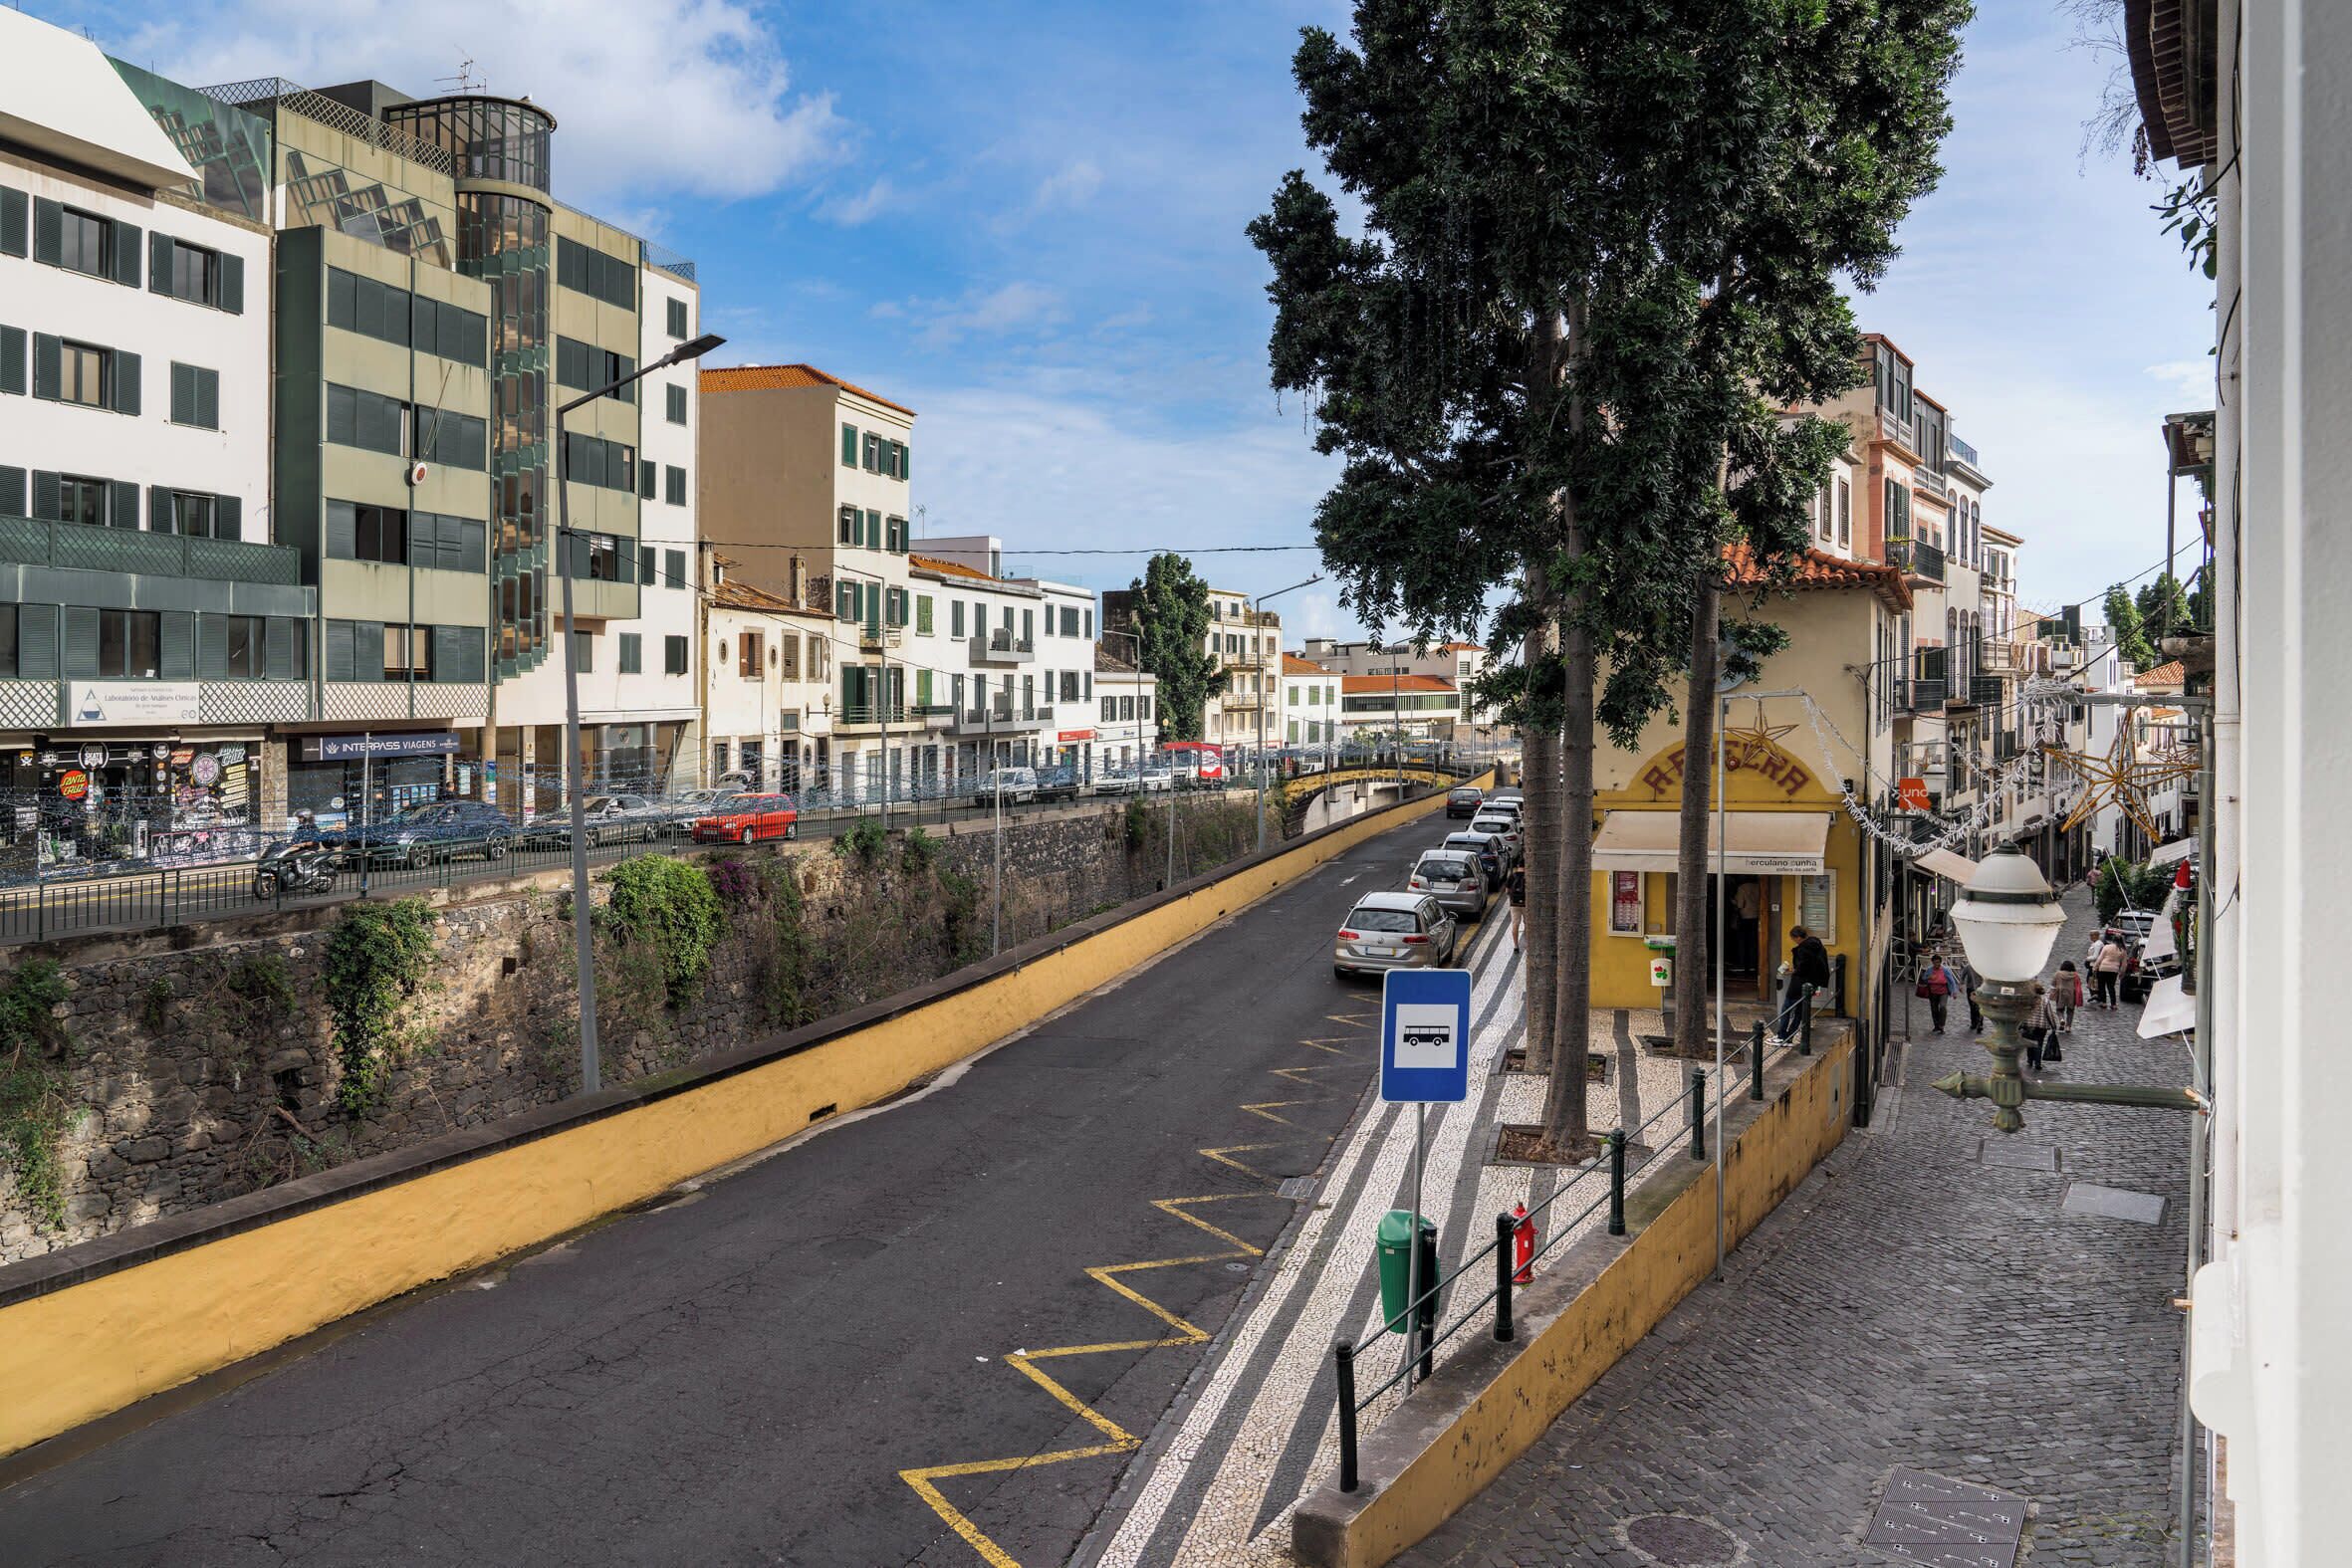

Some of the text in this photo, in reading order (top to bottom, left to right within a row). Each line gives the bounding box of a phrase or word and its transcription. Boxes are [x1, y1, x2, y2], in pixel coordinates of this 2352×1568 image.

[342, 741, 400, 753] INTERPASS
[402, 740, 436, 750] VIAGENS
[61, 774, 87, 786] SANTA
[63, 784, 86, 795] CRUZ
